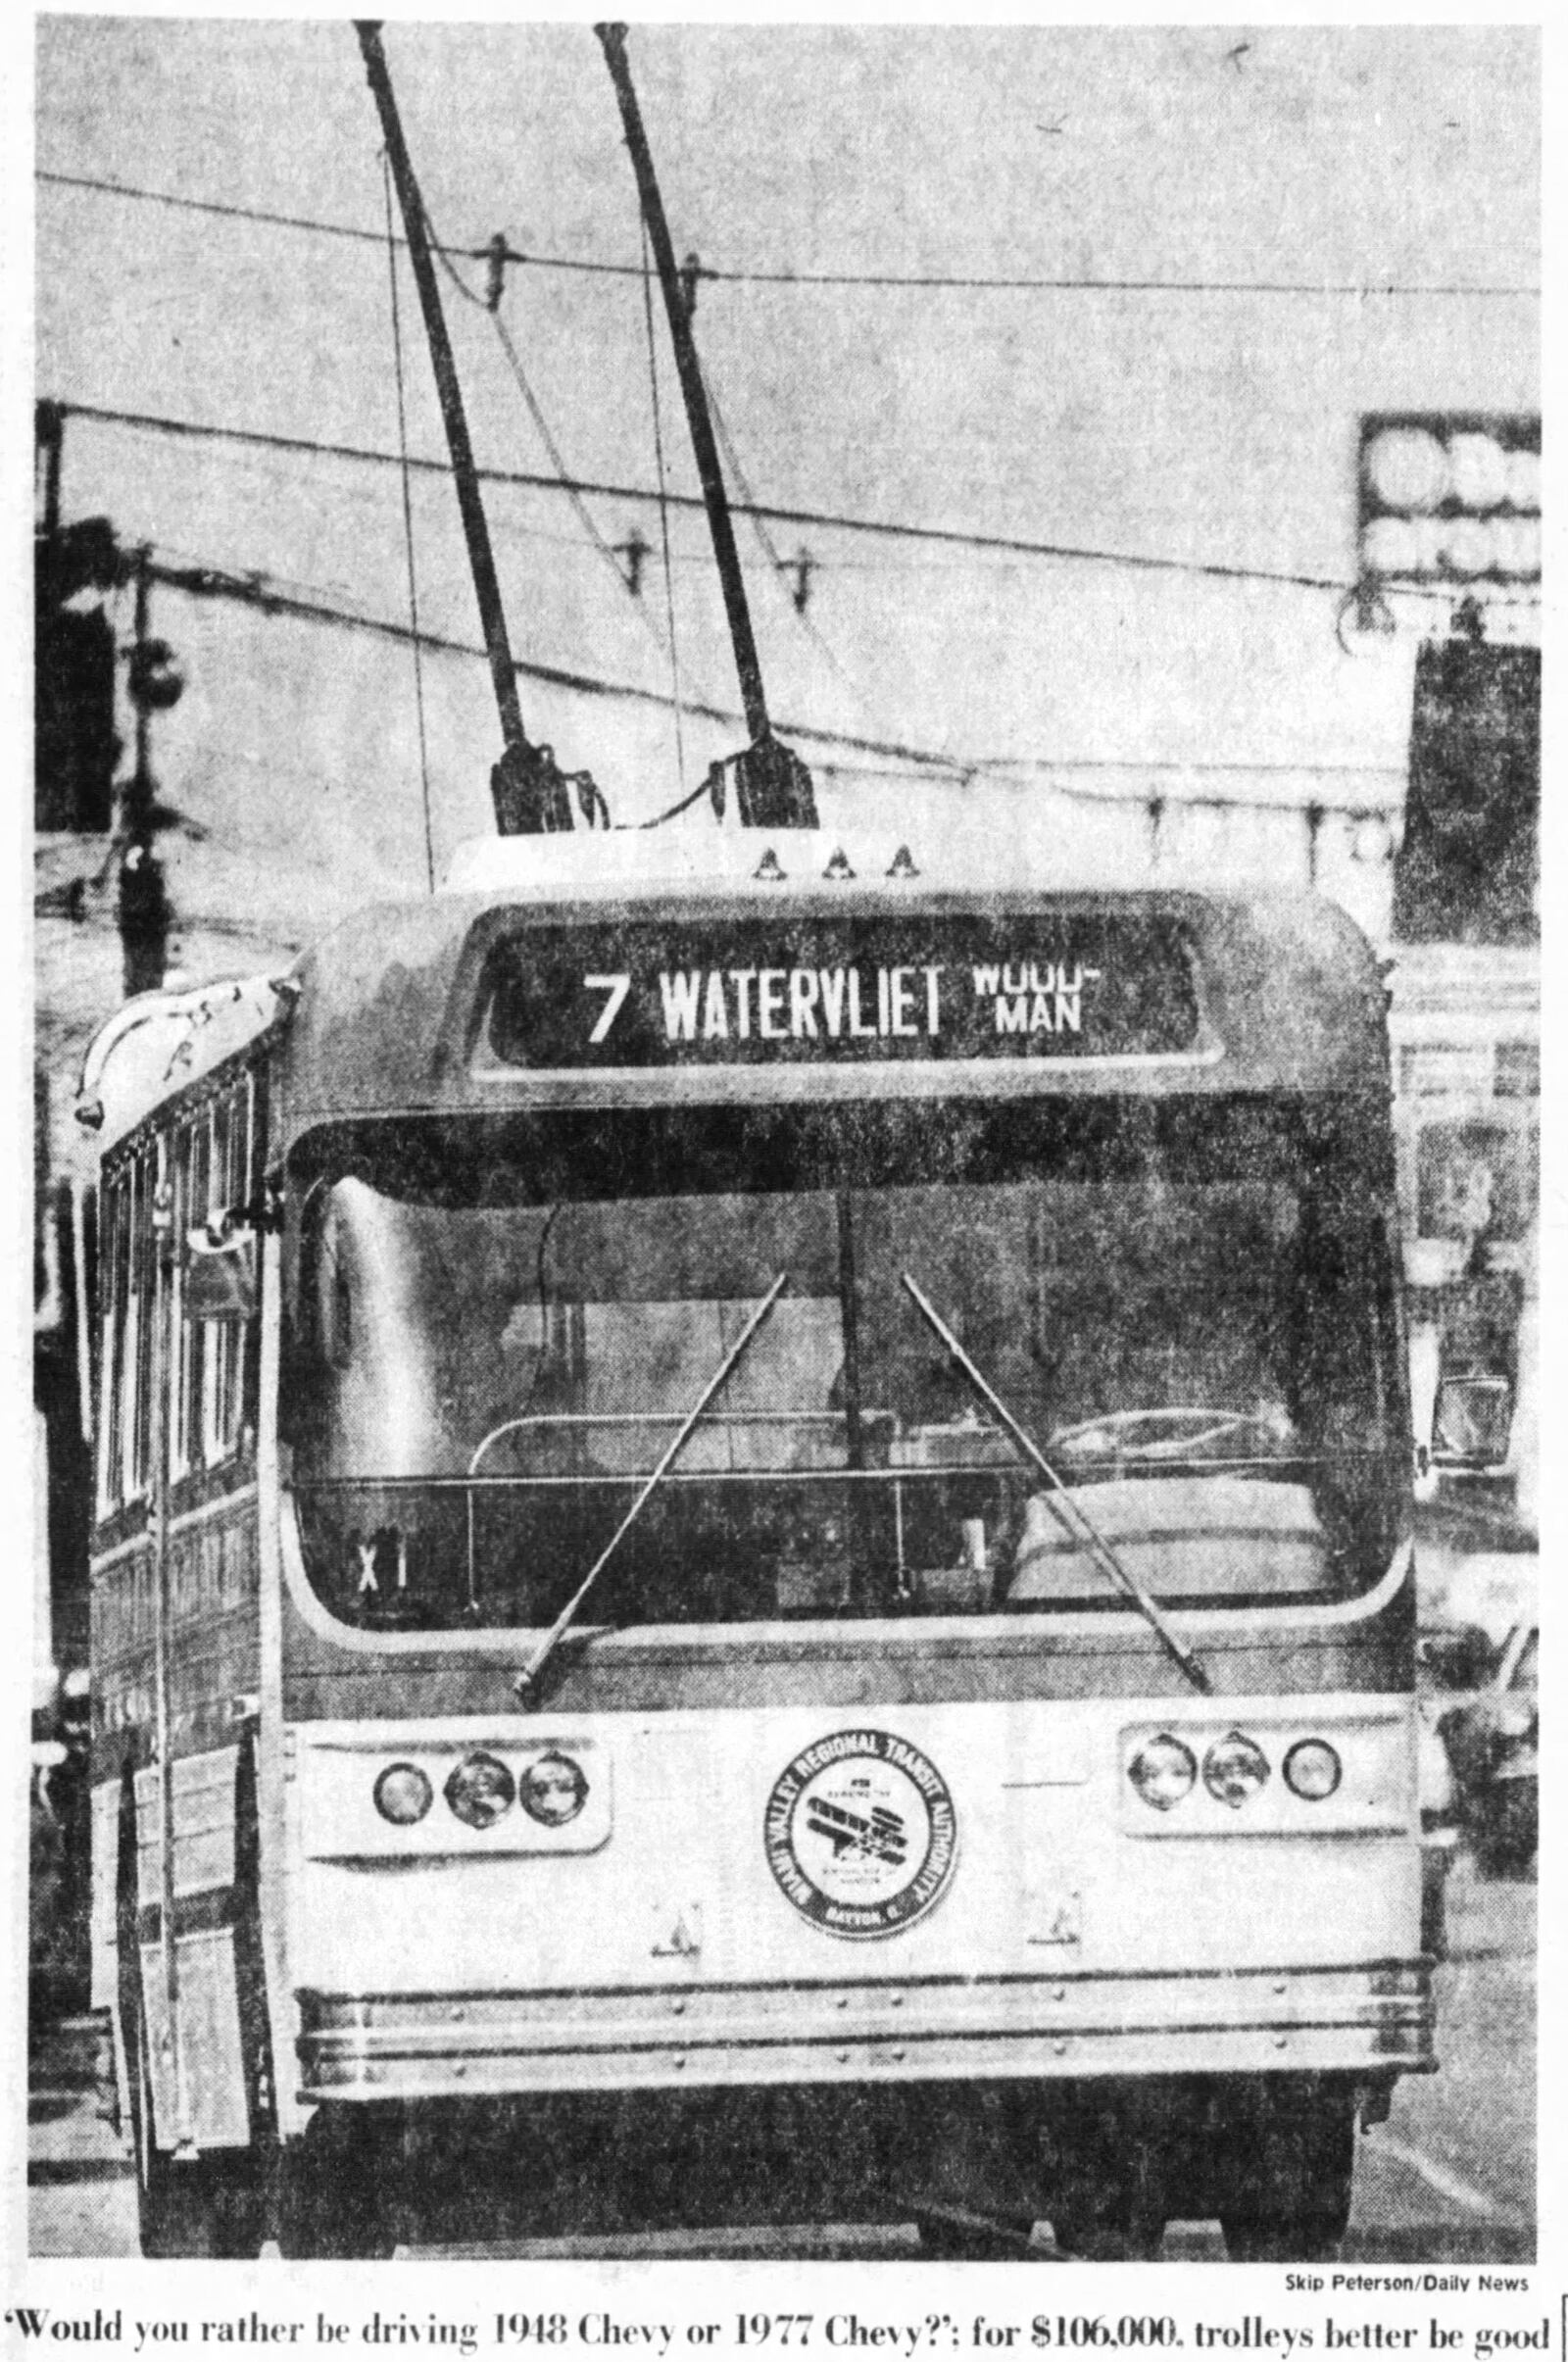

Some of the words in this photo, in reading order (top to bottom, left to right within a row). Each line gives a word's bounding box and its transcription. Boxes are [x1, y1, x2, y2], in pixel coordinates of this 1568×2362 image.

[583, 973, 630, 1043] 7
[660, 964, 944, 1040] WATERVLIET
[995, 993, 1081, 1033] MAN
[794, 1733, 880, 1779] REGIONAL
[885, 1738, 944, 1796] TRANSIT
[767, 1776, 801, 1844] VALLEY
[911, 1800, 953, 1904] AUTHORITY
